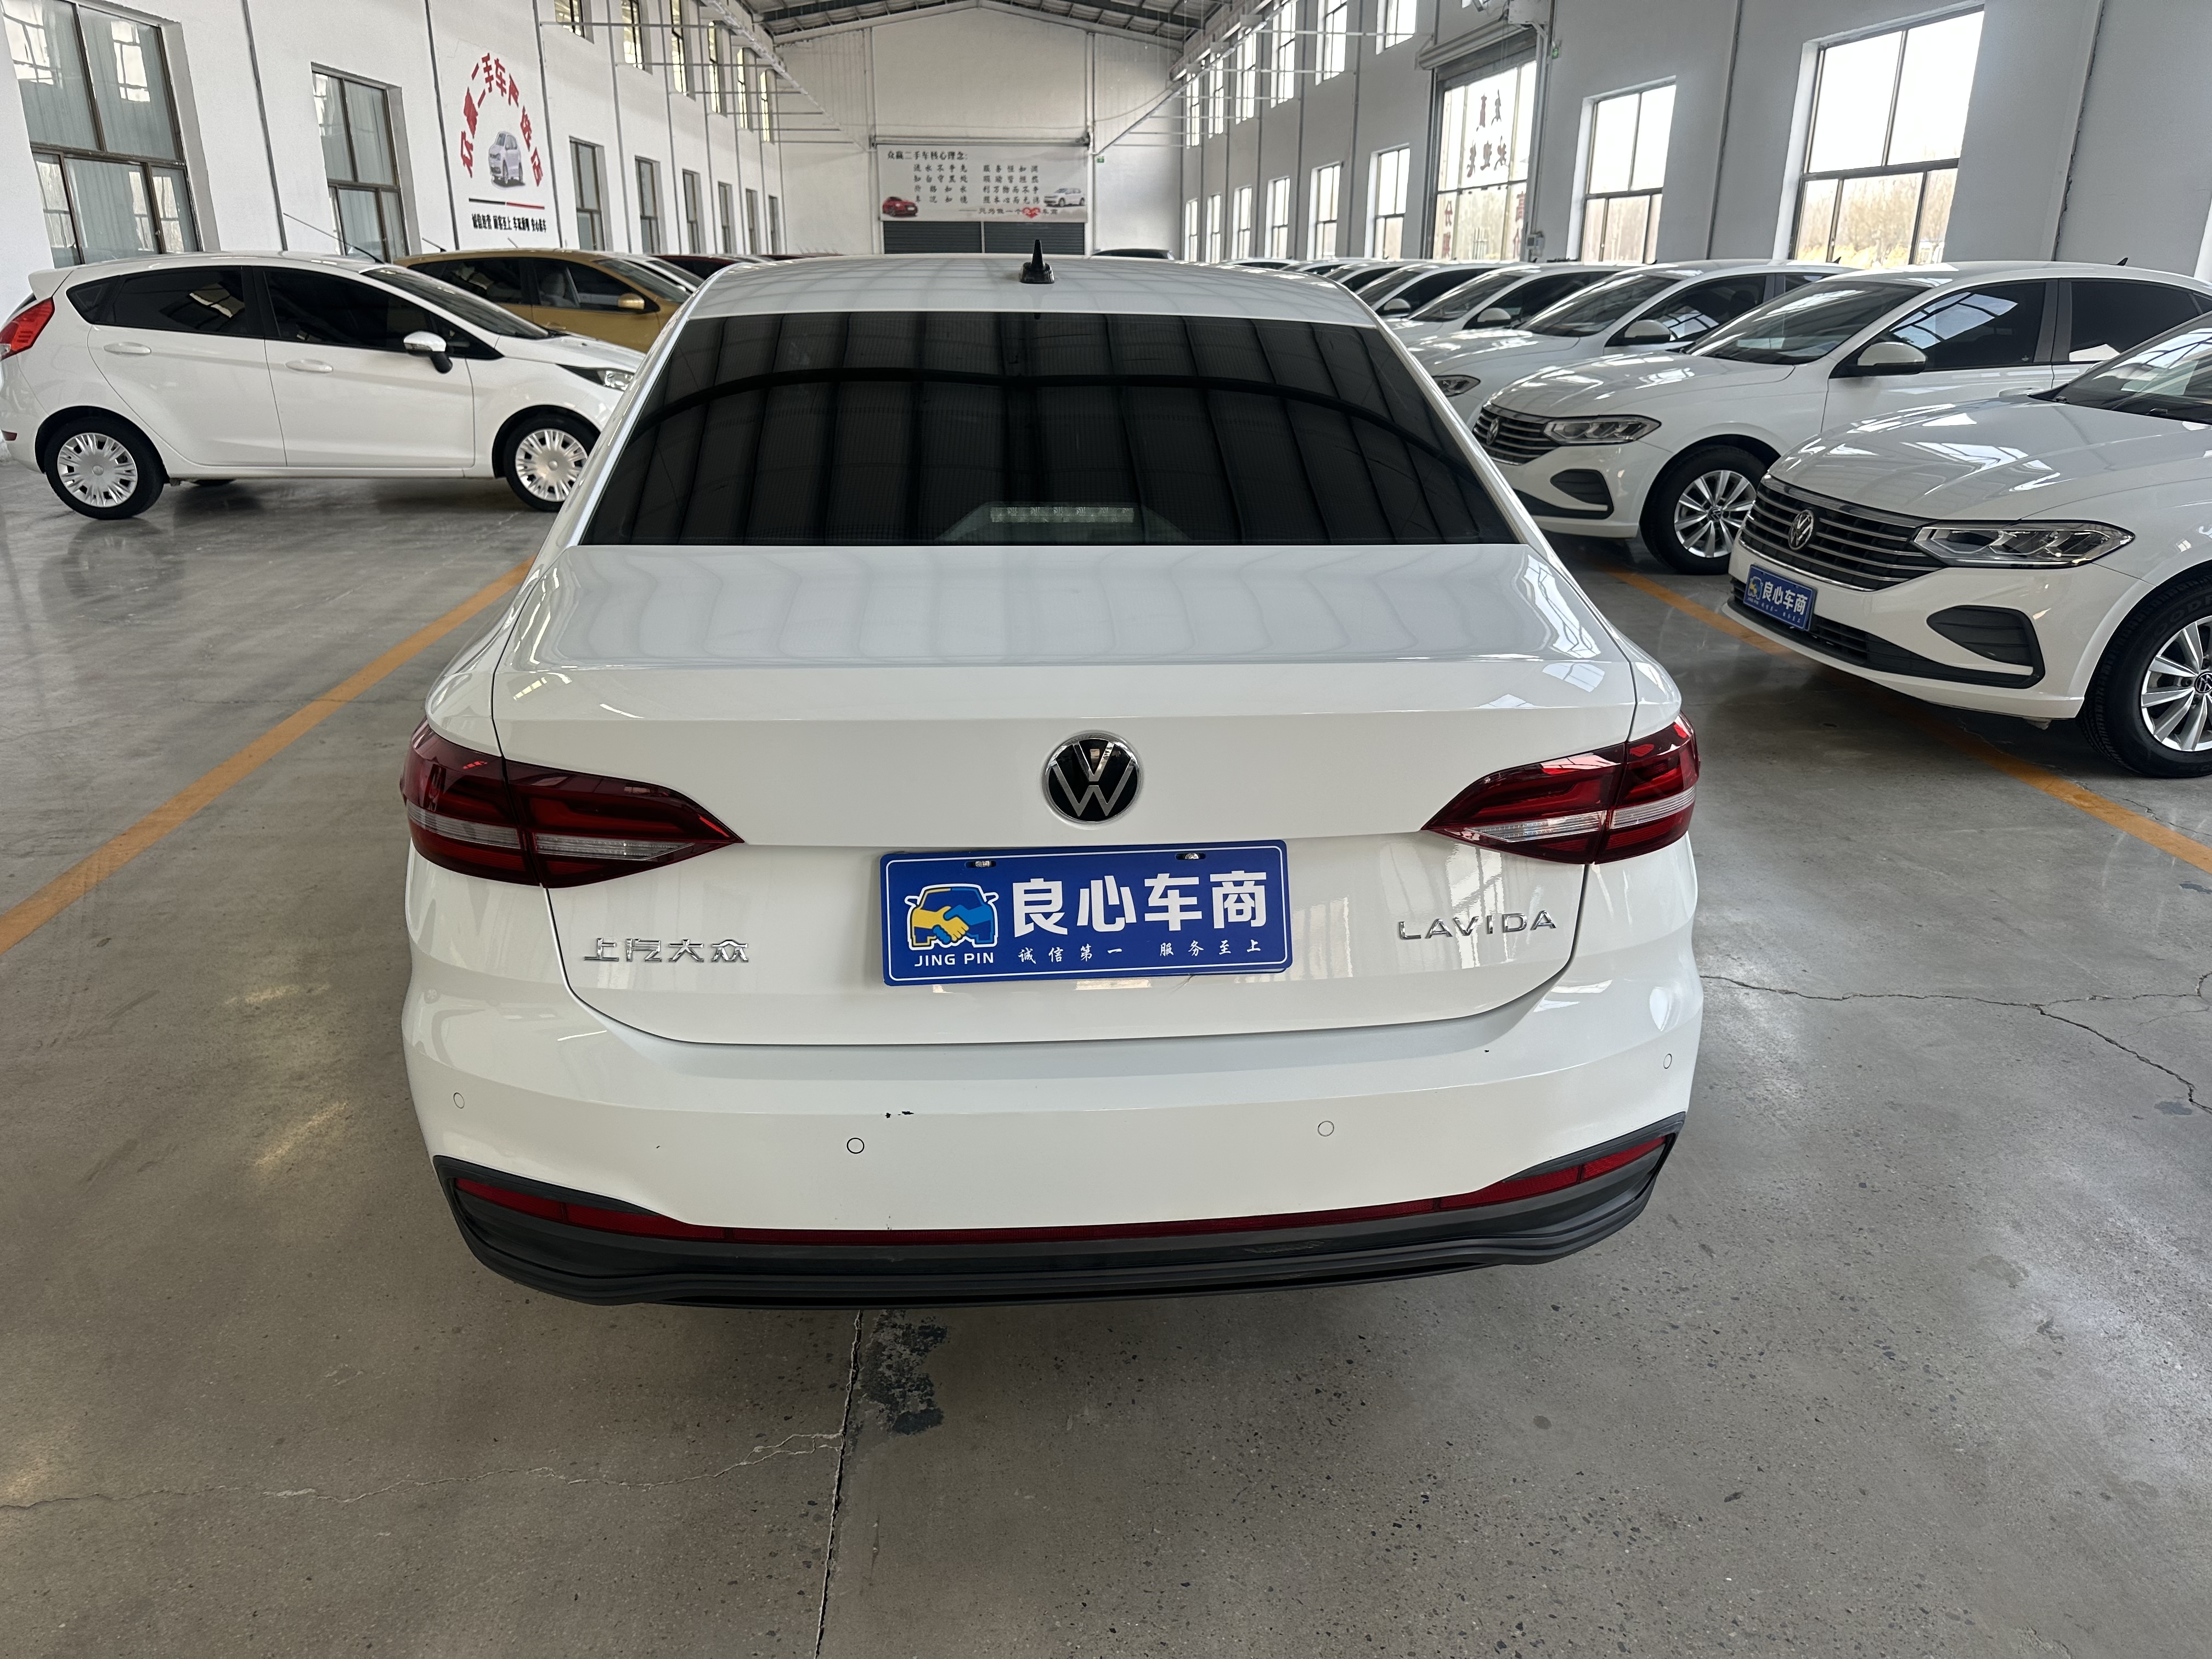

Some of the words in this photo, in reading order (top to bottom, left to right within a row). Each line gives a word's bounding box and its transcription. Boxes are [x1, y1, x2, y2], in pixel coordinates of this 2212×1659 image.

[1762, 582, 1808, 615] 良心车商
[1011, 870, 1267, 937] 良心车商
[1398, 910, 1556, 940] LAVIDA
[584, 938, 749, 963] 上汽大众
[915, 953, 956, 967] JING
[963, 952, 994, 964] PIN
[1018, 943, 1123, 964] 诚信第一
[1159, 939, 1261, 956] 服务至上
